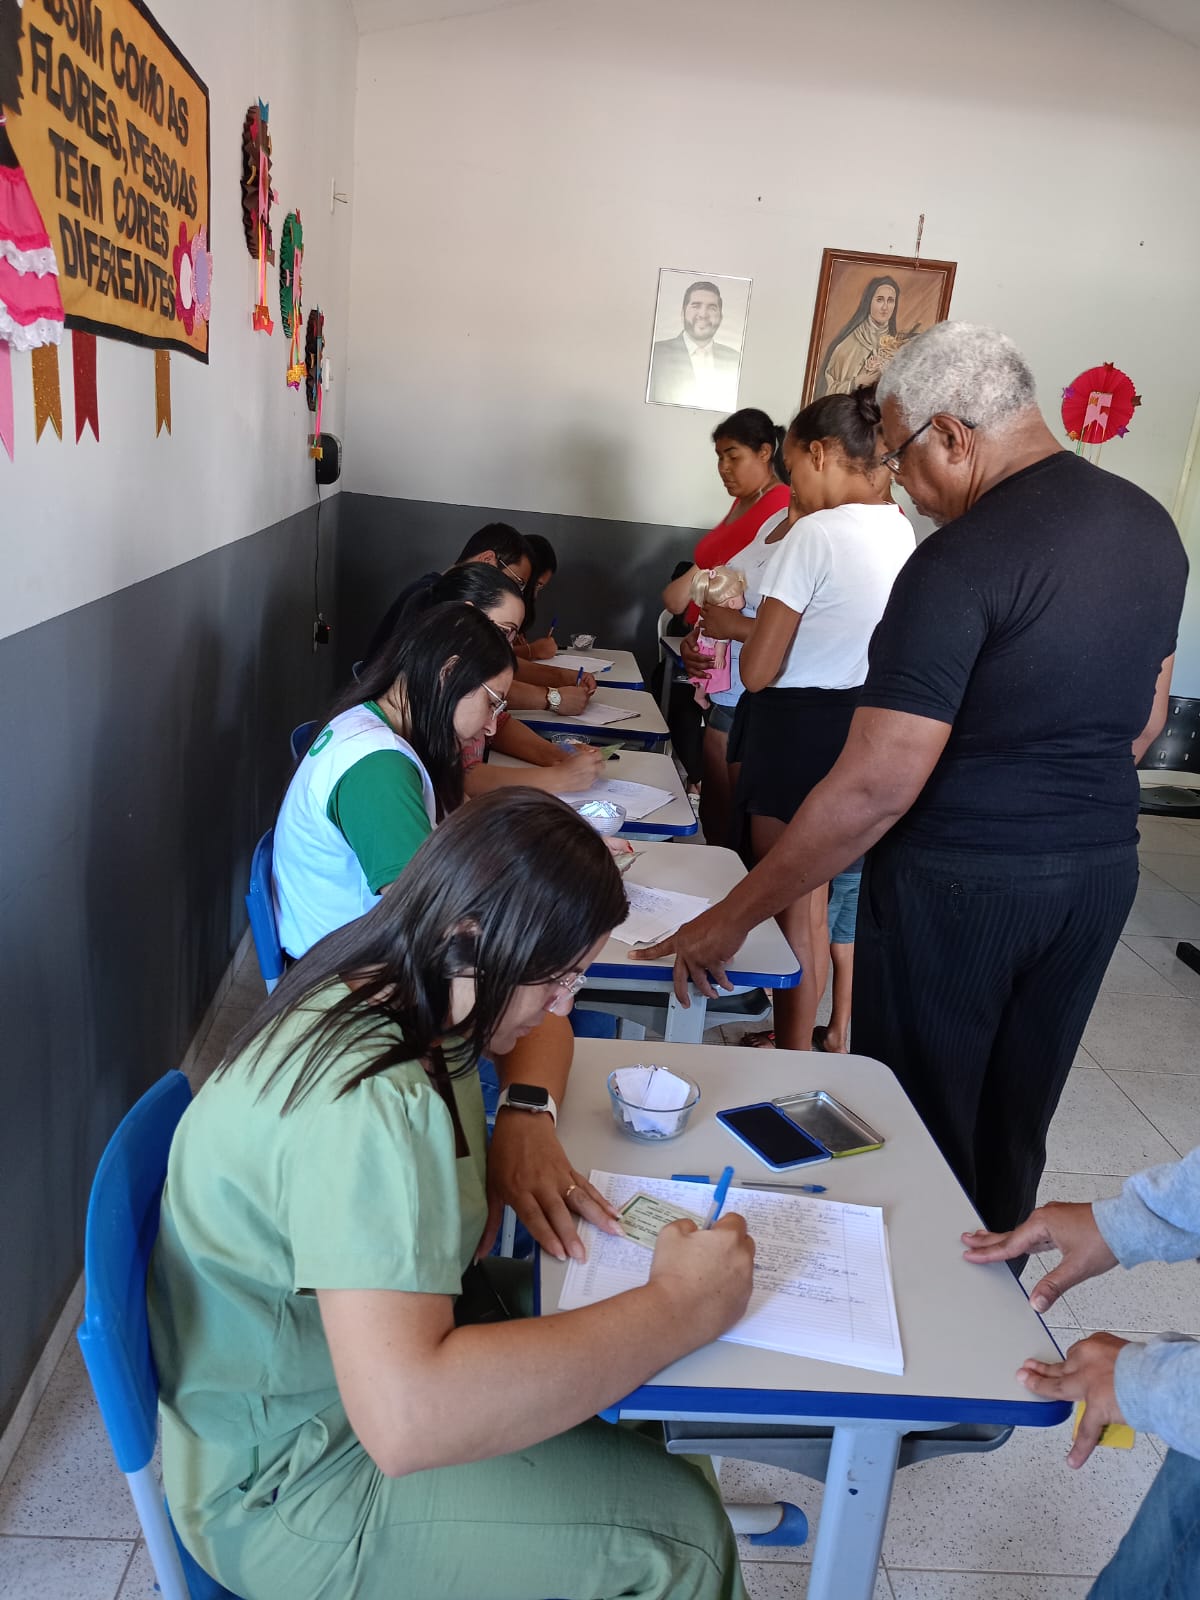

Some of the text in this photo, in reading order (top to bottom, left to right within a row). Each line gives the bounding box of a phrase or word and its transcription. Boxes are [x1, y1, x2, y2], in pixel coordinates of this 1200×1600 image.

[31, 0, 189, 147] SIM COMO AS
[48, 128, 169, 260] TEM CORES
[126, 118, 198, 221] PESSOAS
[58, 213, 176, 321] DIFERENTES
